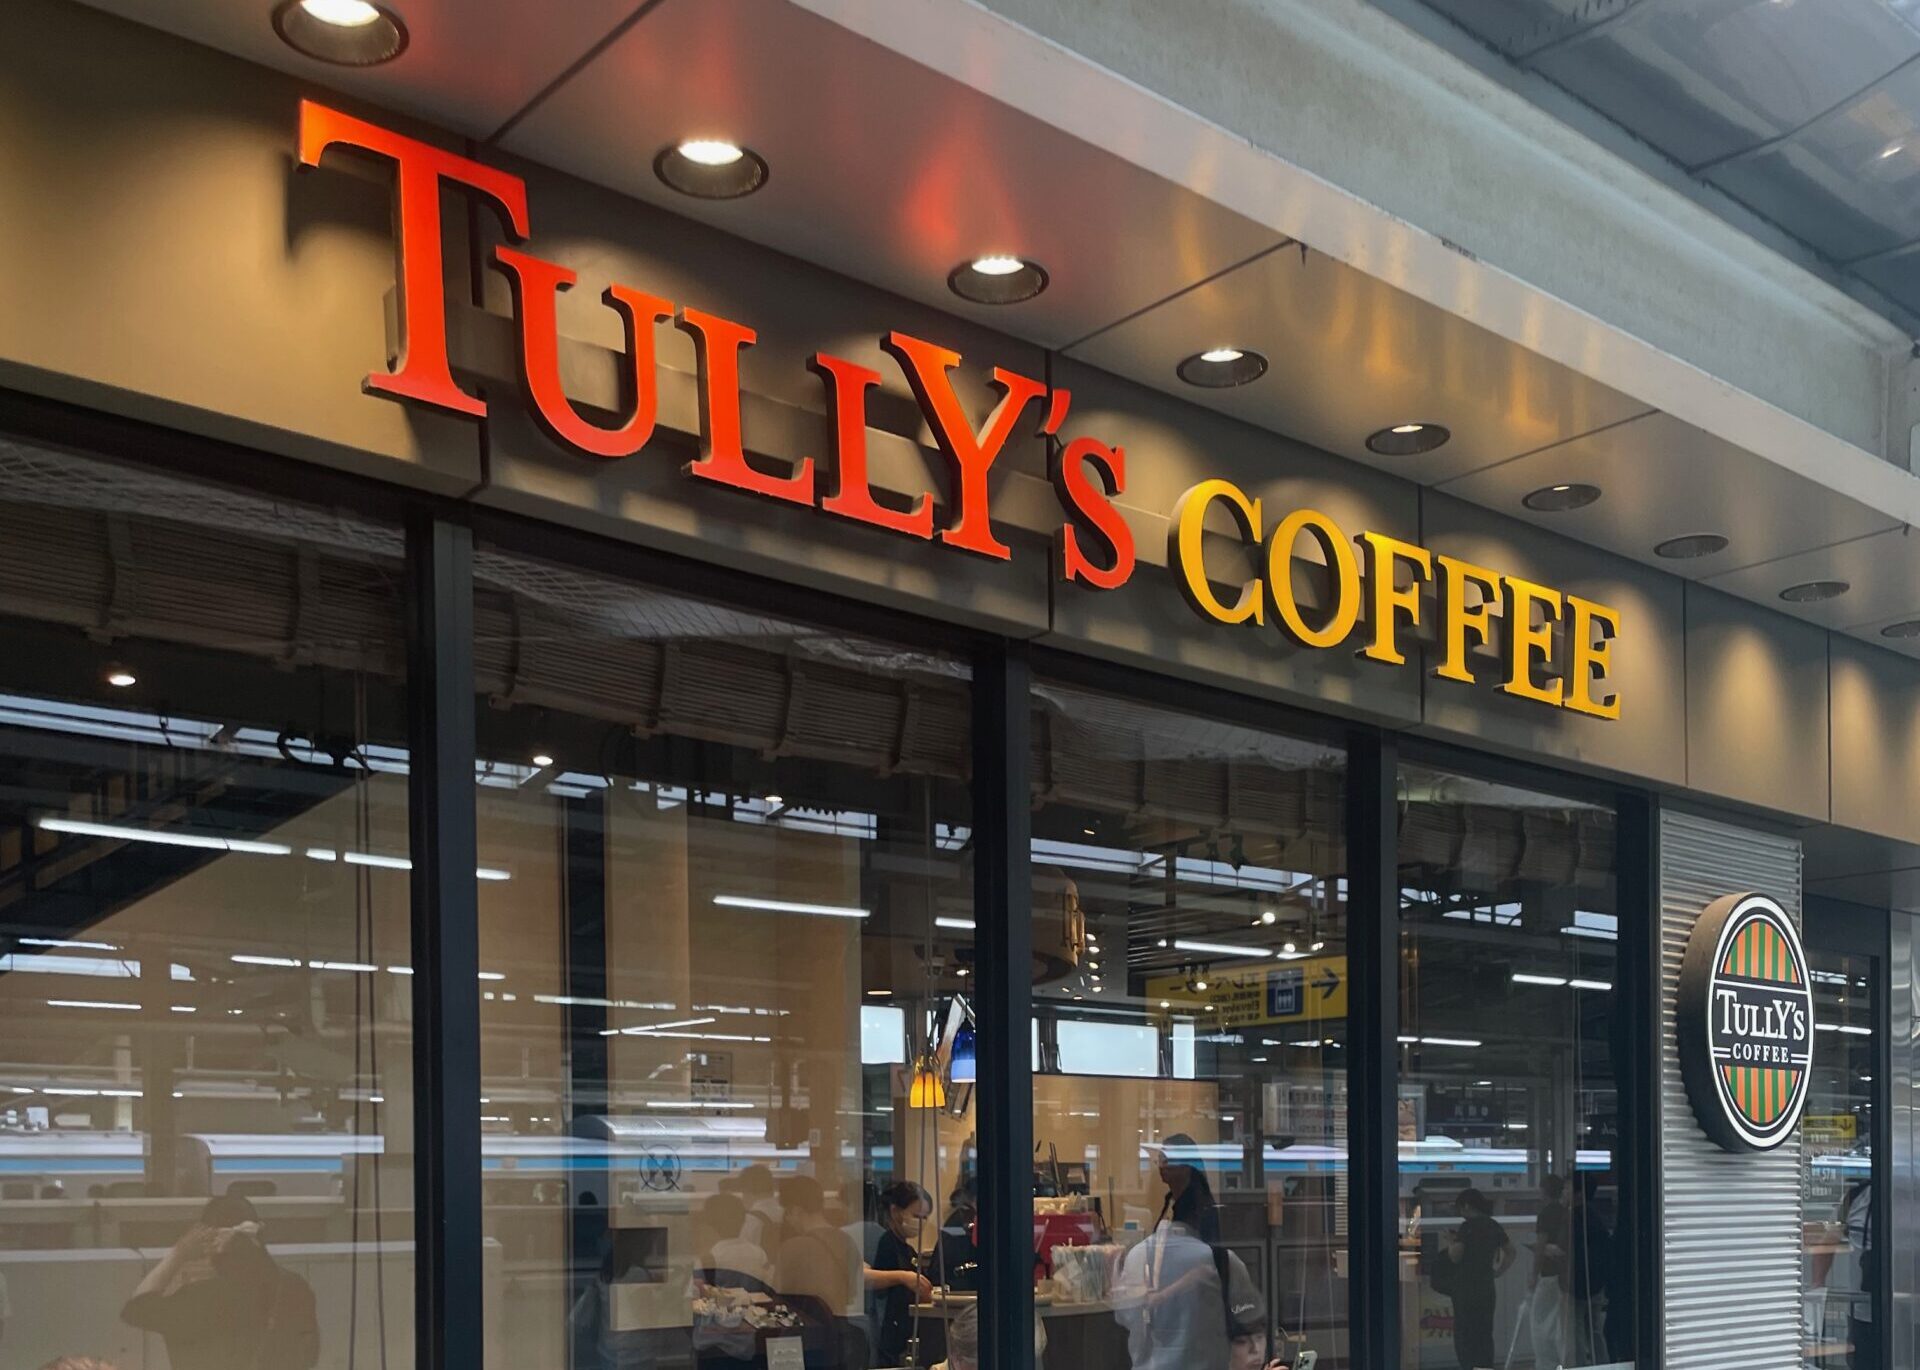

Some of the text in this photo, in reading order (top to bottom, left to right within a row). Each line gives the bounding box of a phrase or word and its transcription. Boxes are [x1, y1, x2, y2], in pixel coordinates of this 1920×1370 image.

[301, 99, 1621, 720] TULLY'S COFFEE
[1716, 989, 1805, 1041] TULLY'S
[1732, 1043, 1789, 1063] COFFEE
